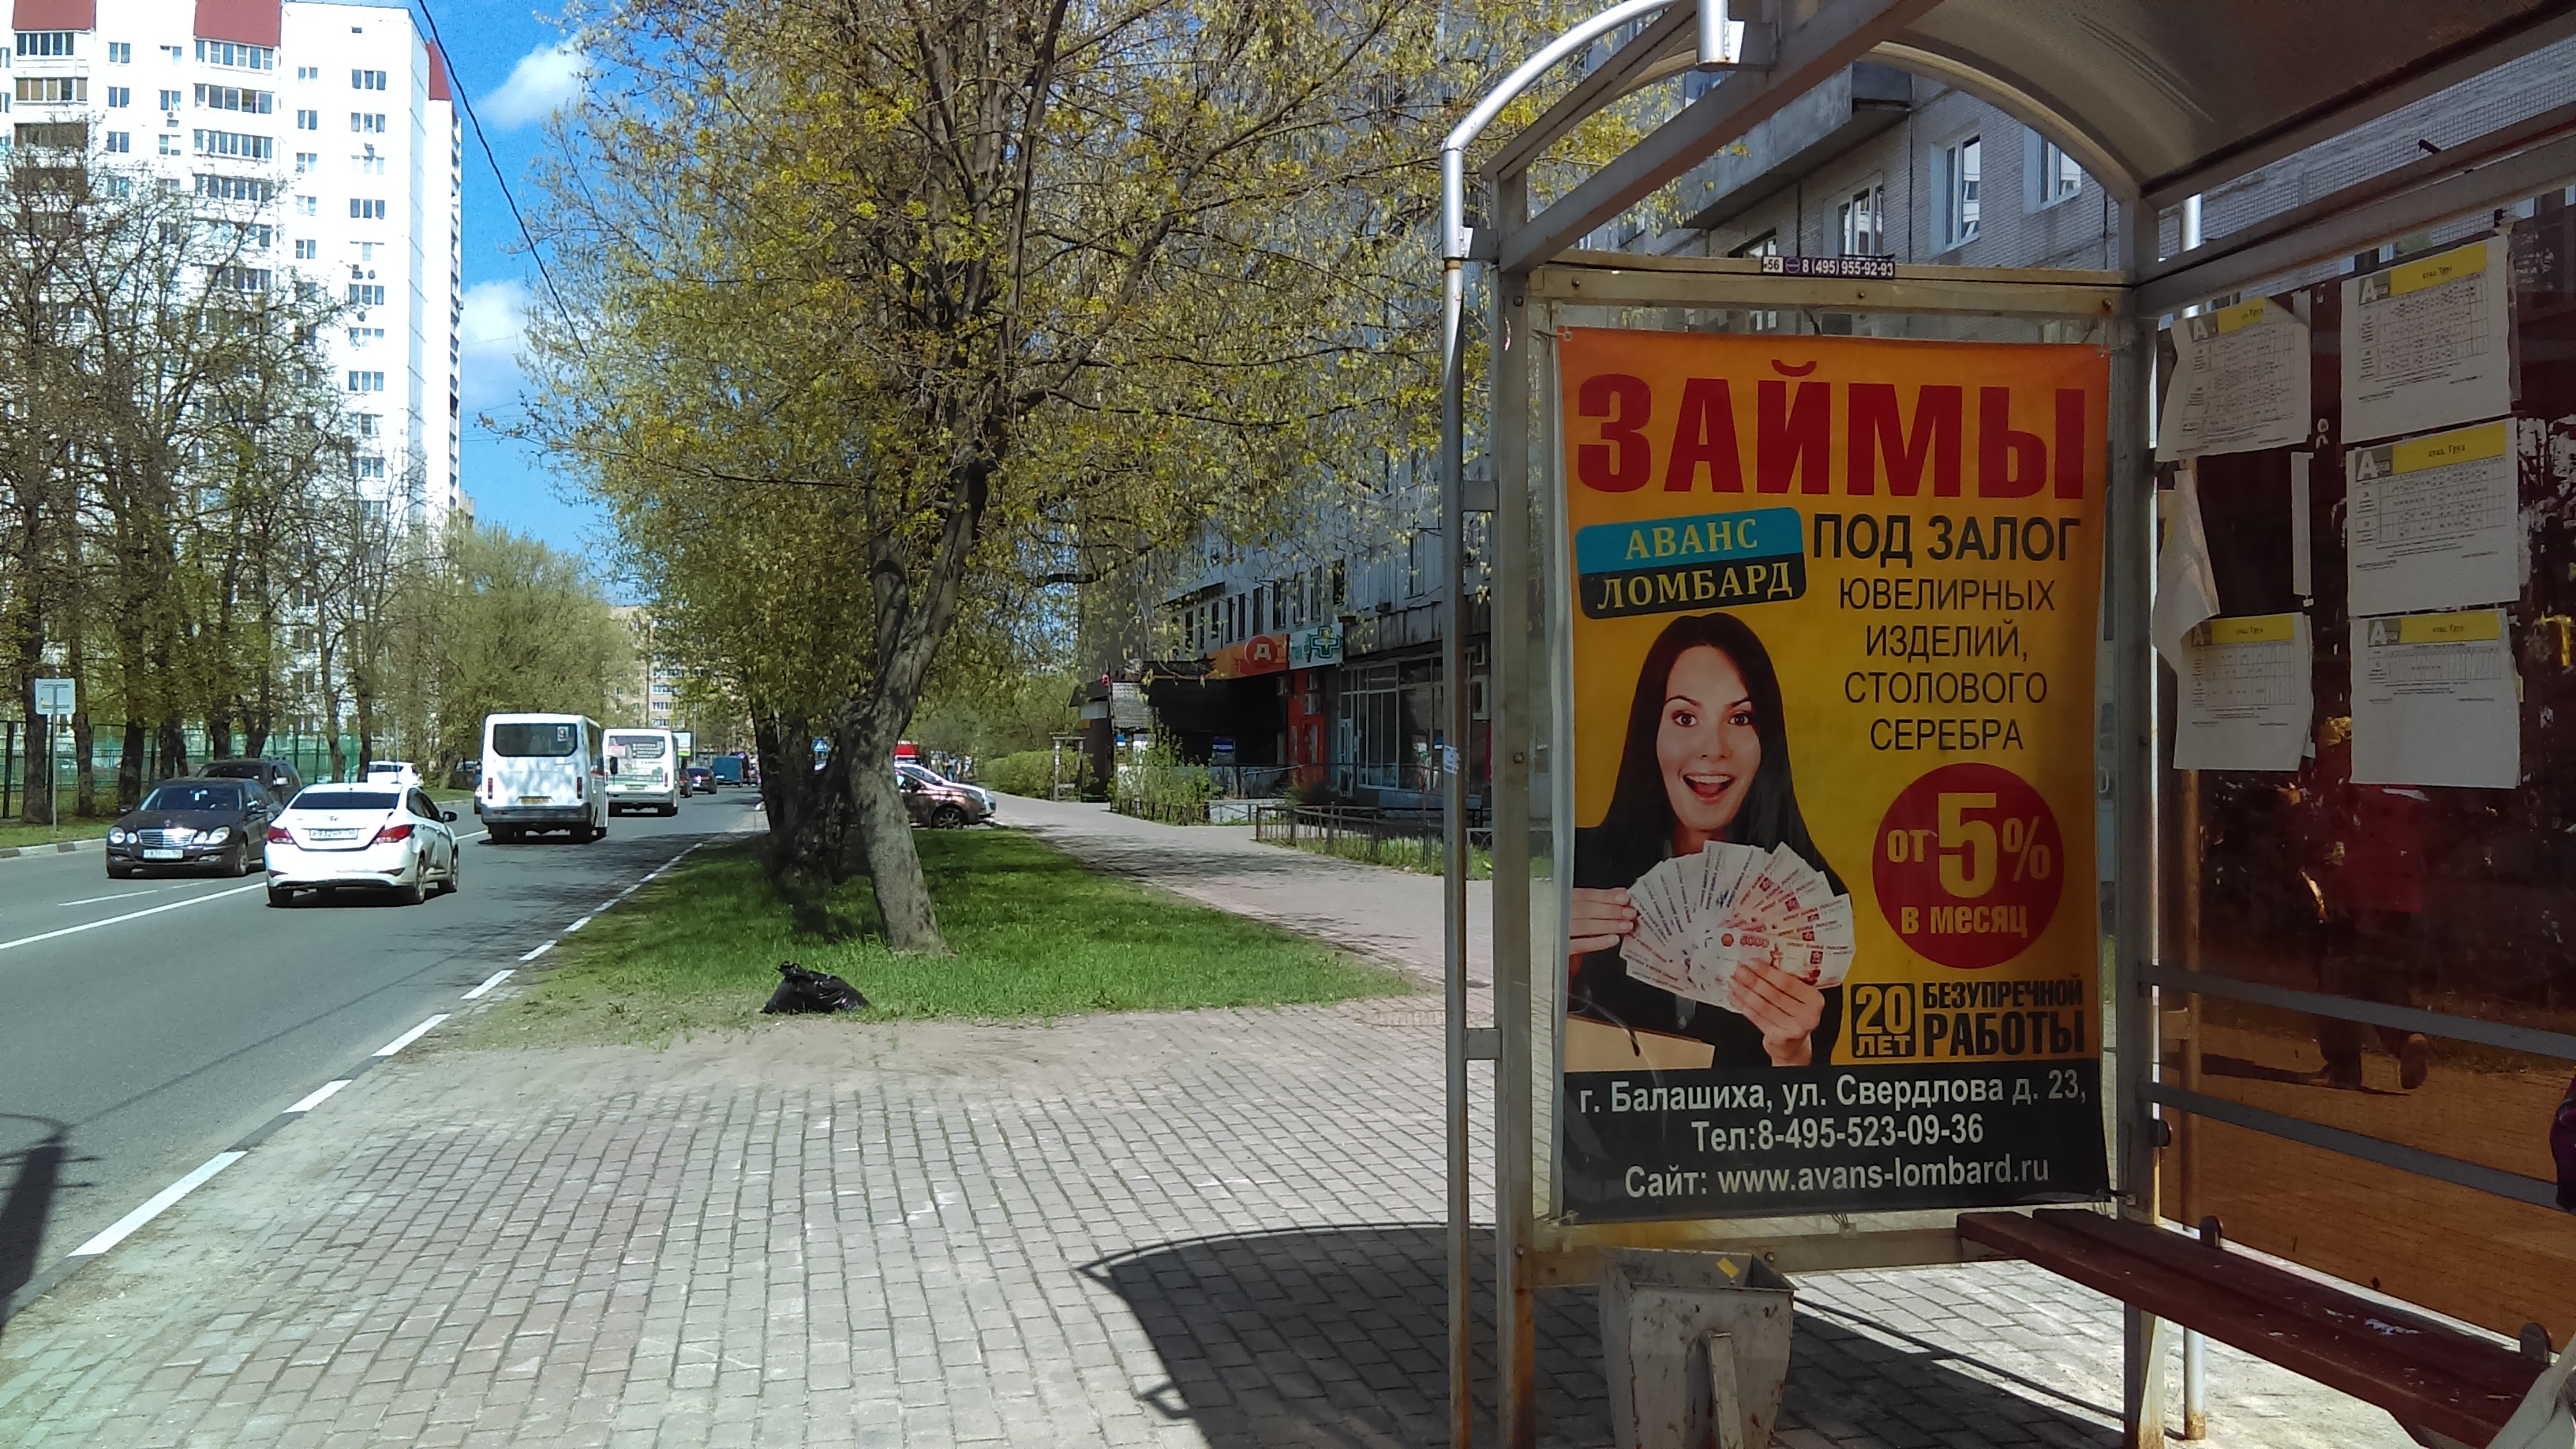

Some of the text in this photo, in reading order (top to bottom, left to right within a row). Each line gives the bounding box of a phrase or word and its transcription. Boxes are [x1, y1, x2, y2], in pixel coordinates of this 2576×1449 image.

[1802, 259, 1810, 273] 8
[1811, 260, 1840, 275] (495)
[1841, 261, 1894, 276] 955-92-93
[1578, 359, 2085, 500] ЗАЙМЫ
[1624, 518, 1758, 560] АВАНС
[1814, 513, 2081, 569] ПОД ЗАЛОГ
[1597, 561, 1793, 611] ЛОМБАРД
[1839, 577, 2056, 611] ЮВЕЛИРНЫХ
[1865, 618, 2027, 663] ИЗДЕЛИЙ,
[1844, 671, 2048, 704] СТОЛОВОГО
[1870, 718, 2024, 751] СЕРЕБРА
[1886, 792, 2051, 899] от 5%
[1900, 905, 2028, 938] в месяц
[1855, 985, 1911, 1035] 20
[1922, 972, 2084, 1009] БЕЗУПРЕЧНОЙ
[1855, 1035, 1911, 1056] ЛЕТ
[1923, 1009, 2085, 1058] РАБОТЫ
[1579, 1069, 2087, 1116] г. Балашиха, ул. Свердлова д. 23,
[1690, 1112, 1984, 1152] Тел:8-495-523-09-36
[1625, 1153, 2050, 1198] Сайт: www.avans-lombard.ru
